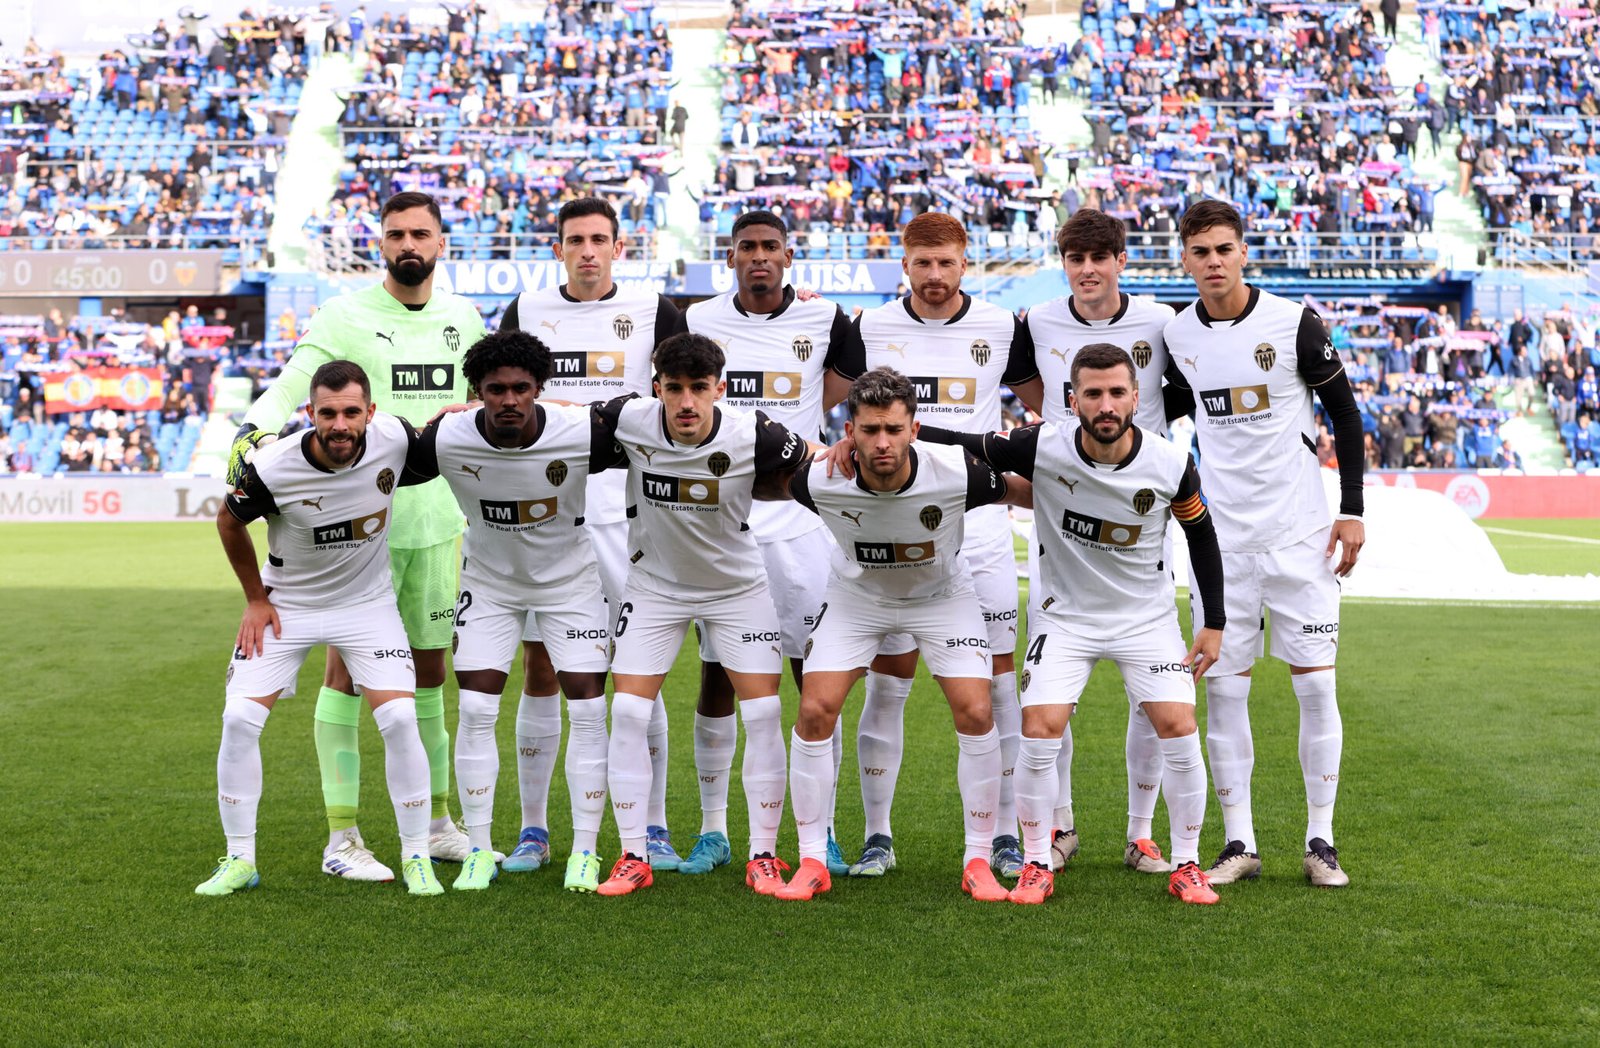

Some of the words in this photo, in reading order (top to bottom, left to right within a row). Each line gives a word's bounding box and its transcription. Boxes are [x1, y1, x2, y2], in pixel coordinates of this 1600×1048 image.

[14, 259, 31, 287] 0
[54, 266, 121, 290] 45:00
[149, 258, 167, 285] 0
[554, 358, 580, 373] TM
[396, 371, 419, 386] TM
[579, 379, 601, 387] Estate
[602, 379, 625, 388] Group
[731, 378, 757, 393] TM
[911, 384, 931, 398] M
[739, 399, 755, 407] Real
[756, 399, 778, 407] Estate
[779, 399, 801, 408] Group
[953, 406, 975, 414] Group
[1205, 396, 1226, 411] TM
[1227, 416, 1249, 425] Estate
[1249, 411, 1273, 422] Group
[645, 479, 671, 497] TM
[0, 489, 73, 516] Móvil
[82, 490, 121, 516] 5G
[671, 504, 694, 512] Estate
[695, 505, 720, 514] Group
[485, 505, 512, 520] TM
[495, 524, 511, 532] Real
[512, 525, 536, 533] Estate
[1067, 517, 1094, 536] TM
[318, 527, 346, 541] TM
[328, 542, 345, 550] Real
[1061, 531, 1073, 541] TM
[1089, 541, 1113, 552] Estate
[860, 547, 888, 560] TM
[453, 590, 473, 627] 2
[614, 602, 634, 638] 6
[946, 637, 990, 650] SKOD
[1026, 634, 1048, 665] 4
[520, 746, 541, 758] VCF
[864, 766, 888, 777] VCF
[1322, 774, 1338, 782] VC
[466, 785, 492, 796] VCF
[1137, 782, 1157, 792] VCF
[585, 790, 606, 800] VCF
[402, 798, 428, 809] VCF
[614, 800, 636, 810] VCF
[760, 799, 783, 809] VCF
[970, 809, 993, 820] VCF
[1021, 819, 1042, 828] VCF
